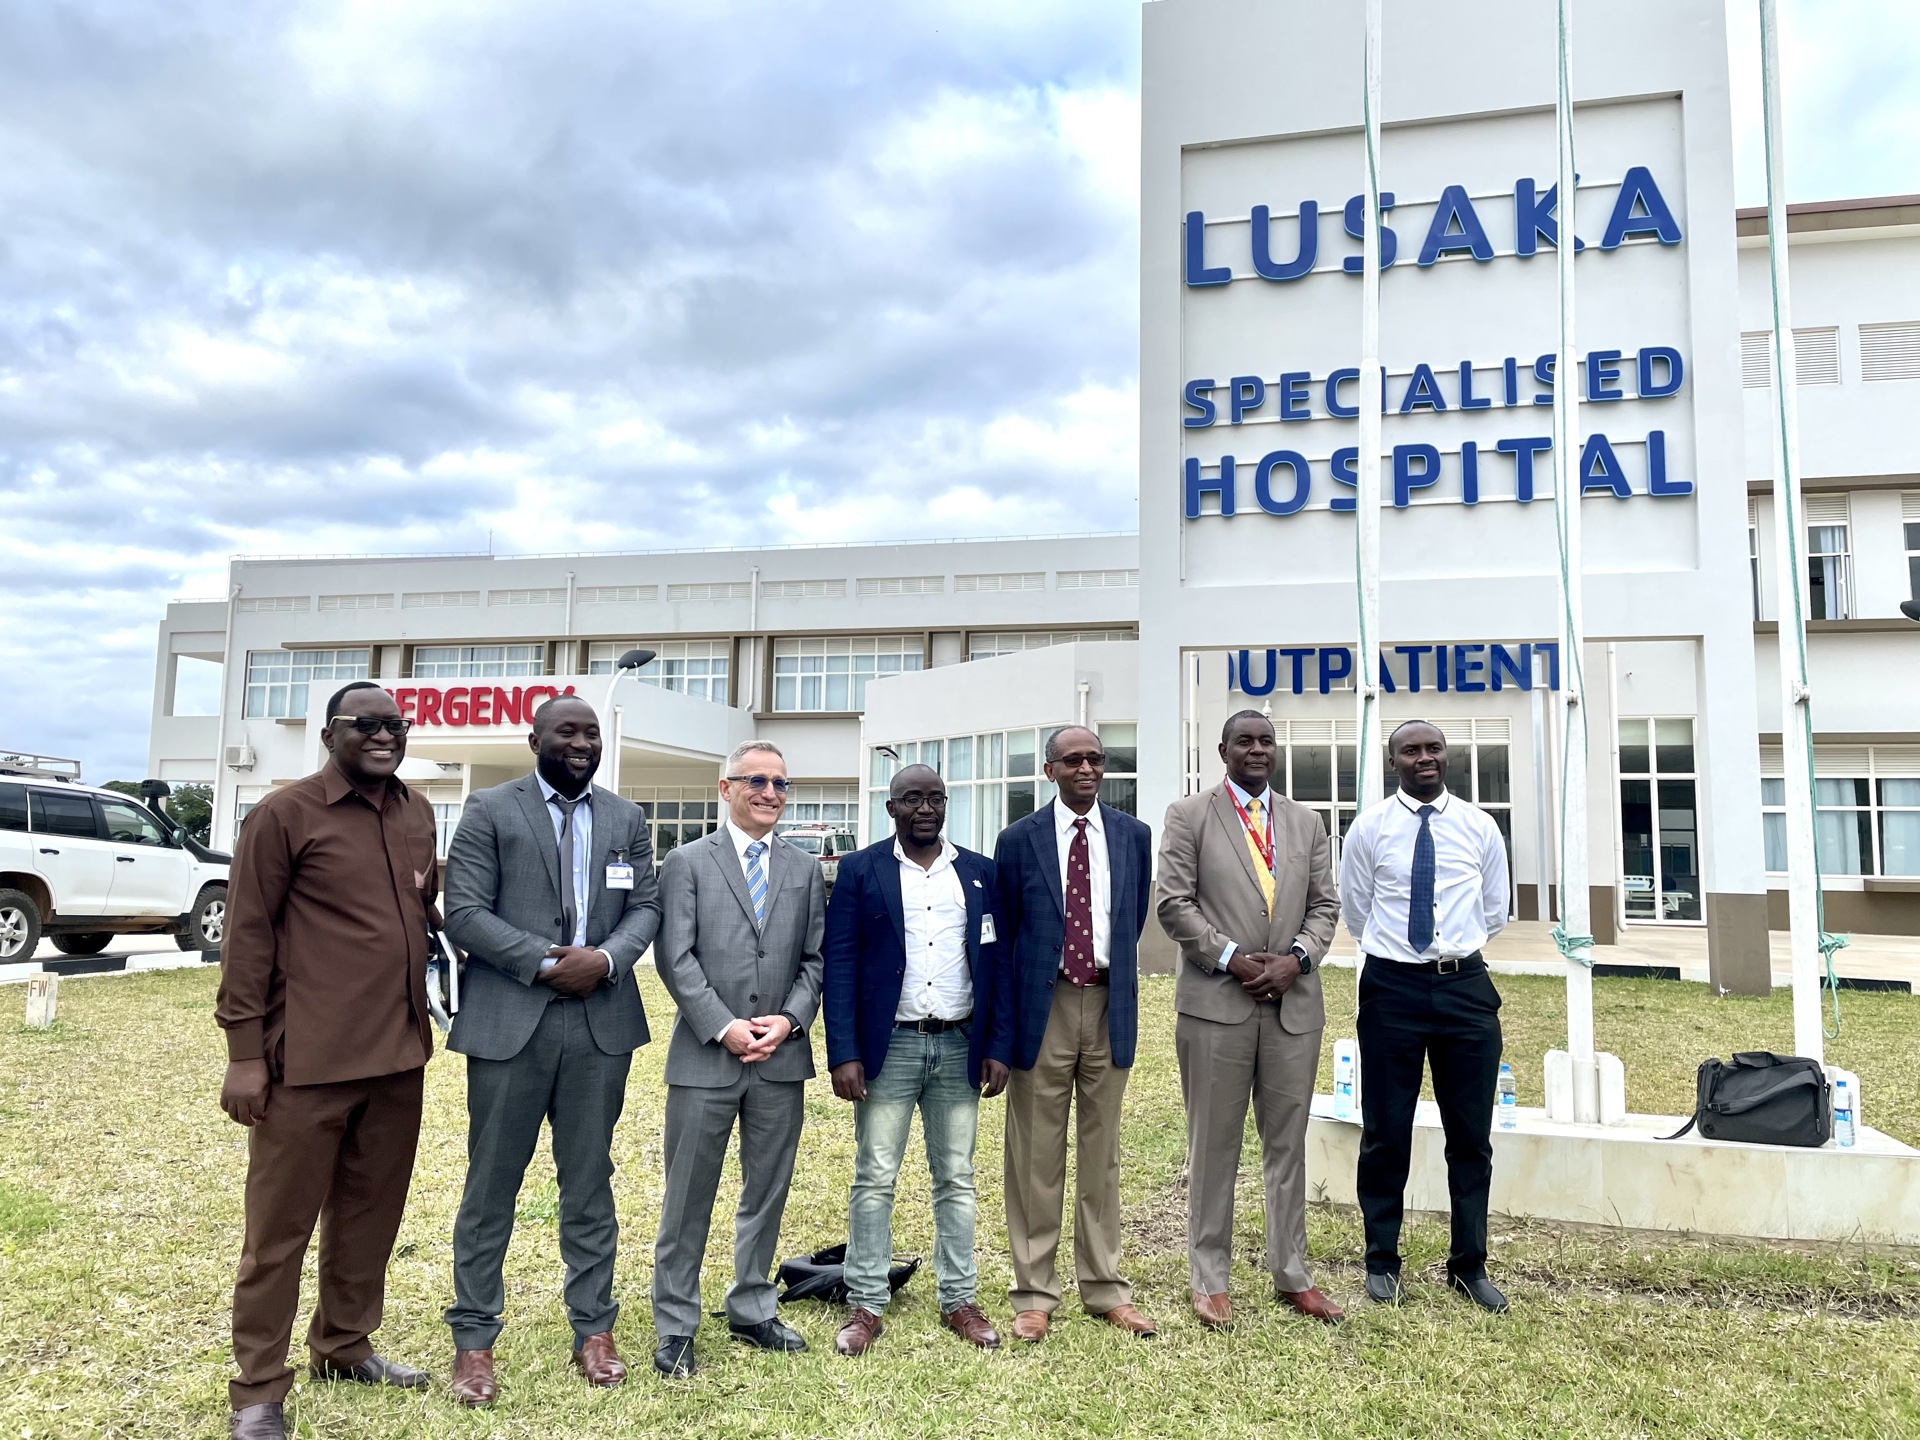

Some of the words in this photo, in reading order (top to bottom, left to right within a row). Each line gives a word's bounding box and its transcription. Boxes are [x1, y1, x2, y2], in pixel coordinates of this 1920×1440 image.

[1184, 166, 1683, 288] LUSAKA
[1184, 429, 1694, 519] HOSPITAL
[1197, 643, 1560, 697] UTPTIENT
[384, 684, 576, 727] ERGENC
[30, 980, 48, 997] FW
